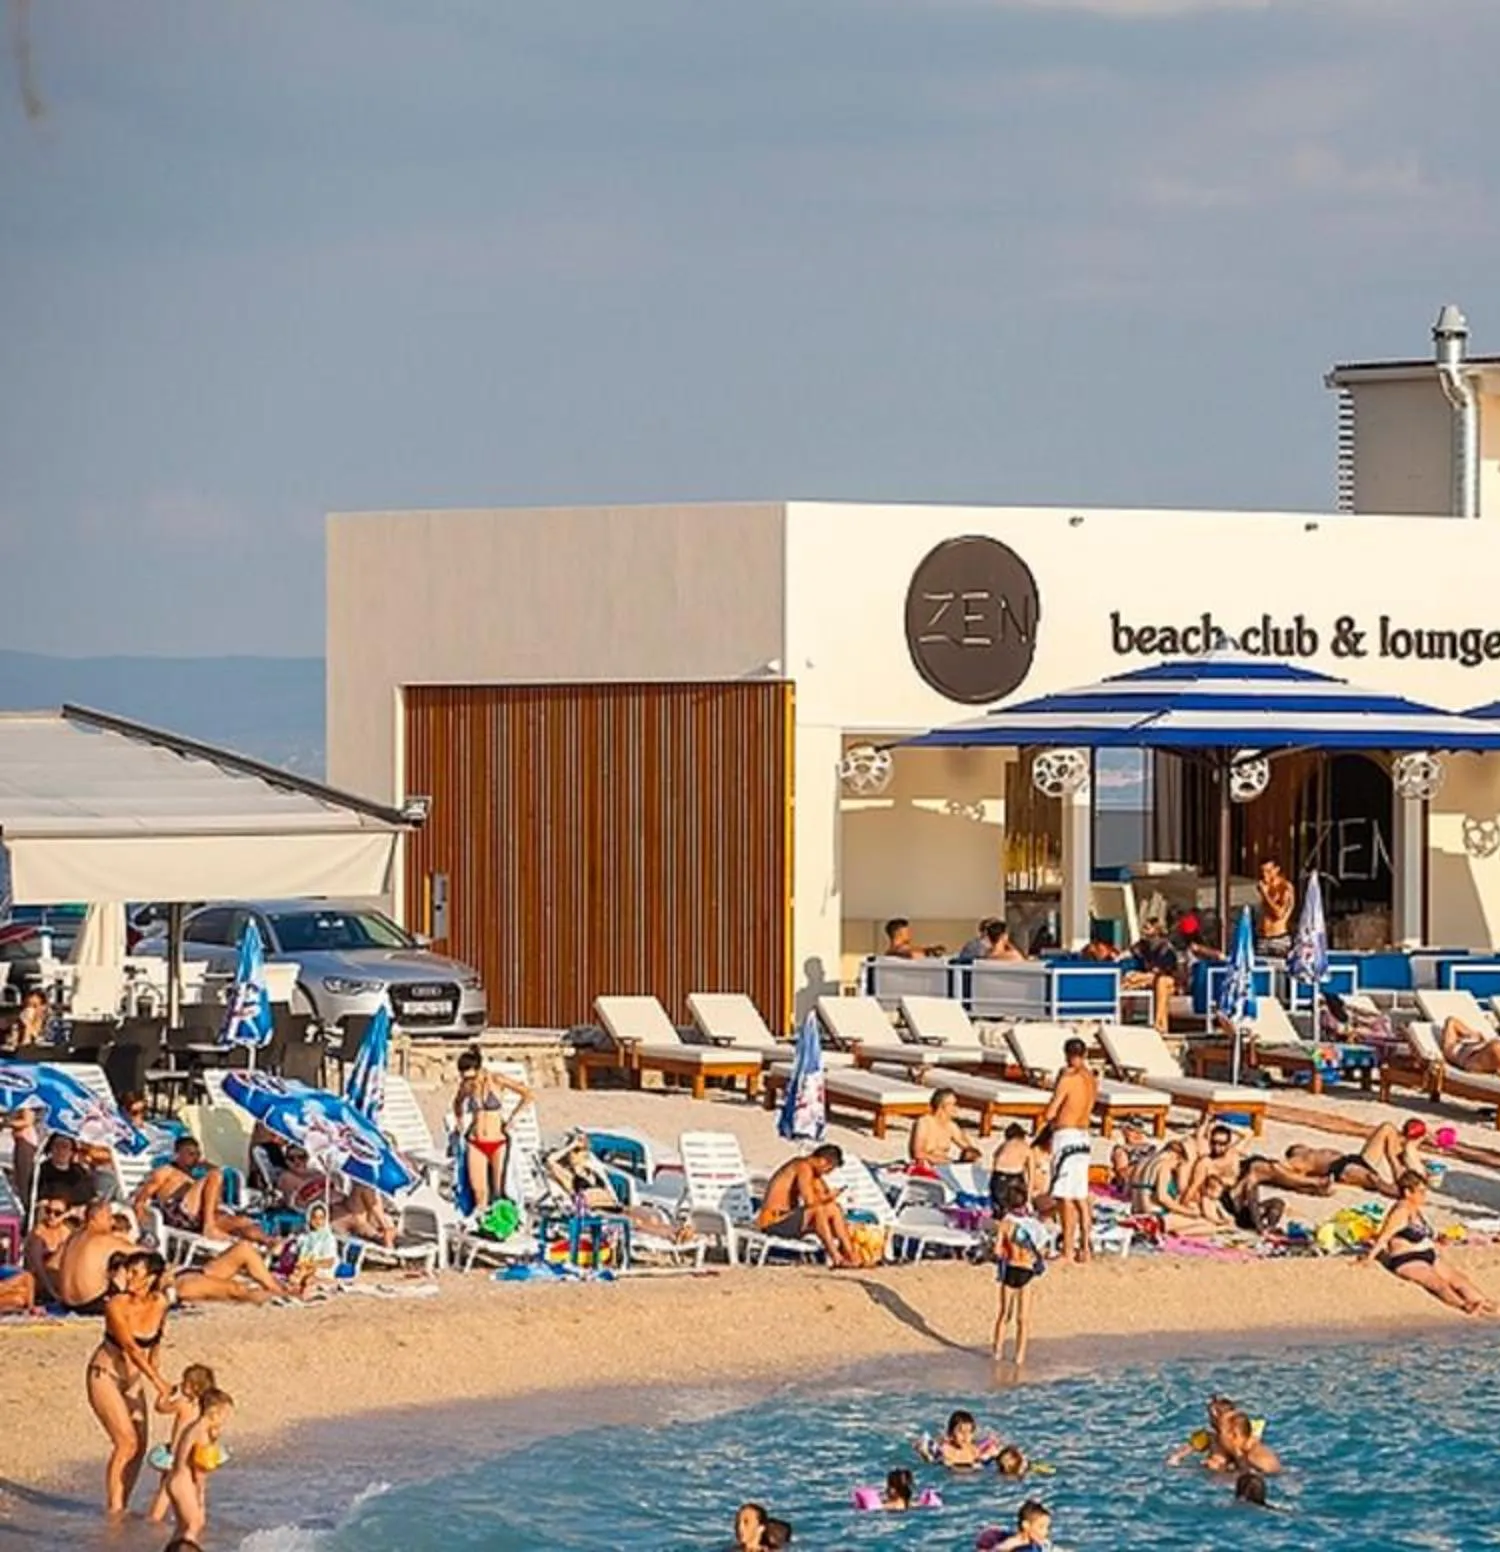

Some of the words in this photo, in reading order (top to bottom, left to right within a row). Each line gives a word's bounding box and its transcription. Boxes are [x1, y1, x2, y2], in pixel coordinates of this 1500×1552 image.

[918, 591, 1030, 647] ZEN
[1109, 611, 1224, 655] beach
[1239, 613, 1318, 657] club
[1330, 615, 1368, 658] &
